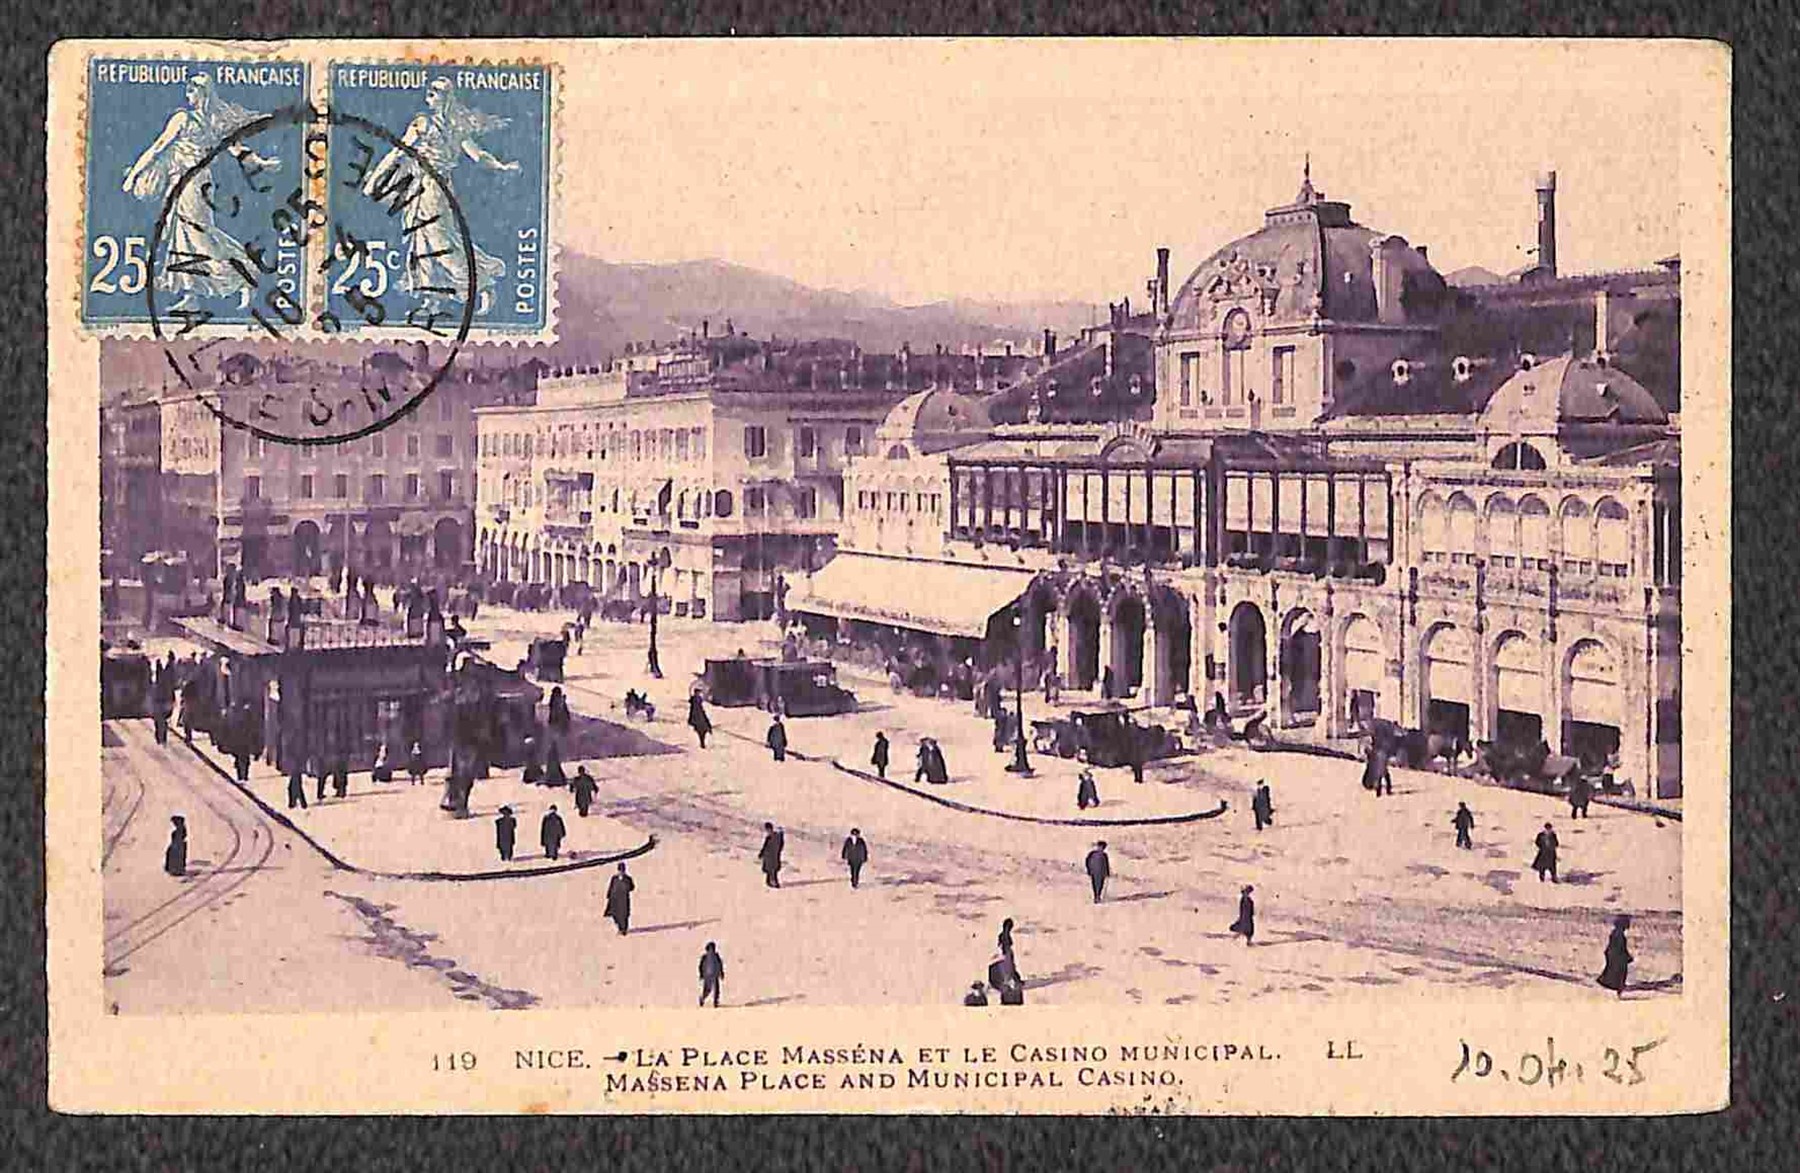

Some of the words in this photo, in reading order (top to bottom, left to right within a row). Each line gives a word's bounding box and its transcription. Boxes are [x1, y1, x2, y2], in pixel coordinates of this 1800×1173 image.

[216, 66, 302, 87] FRANÇAISE
[514, 227, 538, 314] POSTES
[431, 1050, 477, 1071] 119
[515, 1049, 591, 1070] NICE.
[637, 1049, 668, 1068] LA
[682, 1048, 769, 1067] PLACE
[783, 1043, 904, 1066] MASSÉNA
[918, 1047, 950, 1064] ET
[964, 1047, 997, 1064] LE
[1010, 1043, 1108, 1063] CASINO
[1120, 1043, 1281, 1063] MUNICIPAL.
[605, 1073, 728, 1093] MASSENA
[741, 1072, 826, 1091] PLACE
[840, 1072, 896, 1090] AND
[907, 1069, 1063, 1089] MUNICIPAL
[1077, 1067, 1184, 1088] CASINO.
